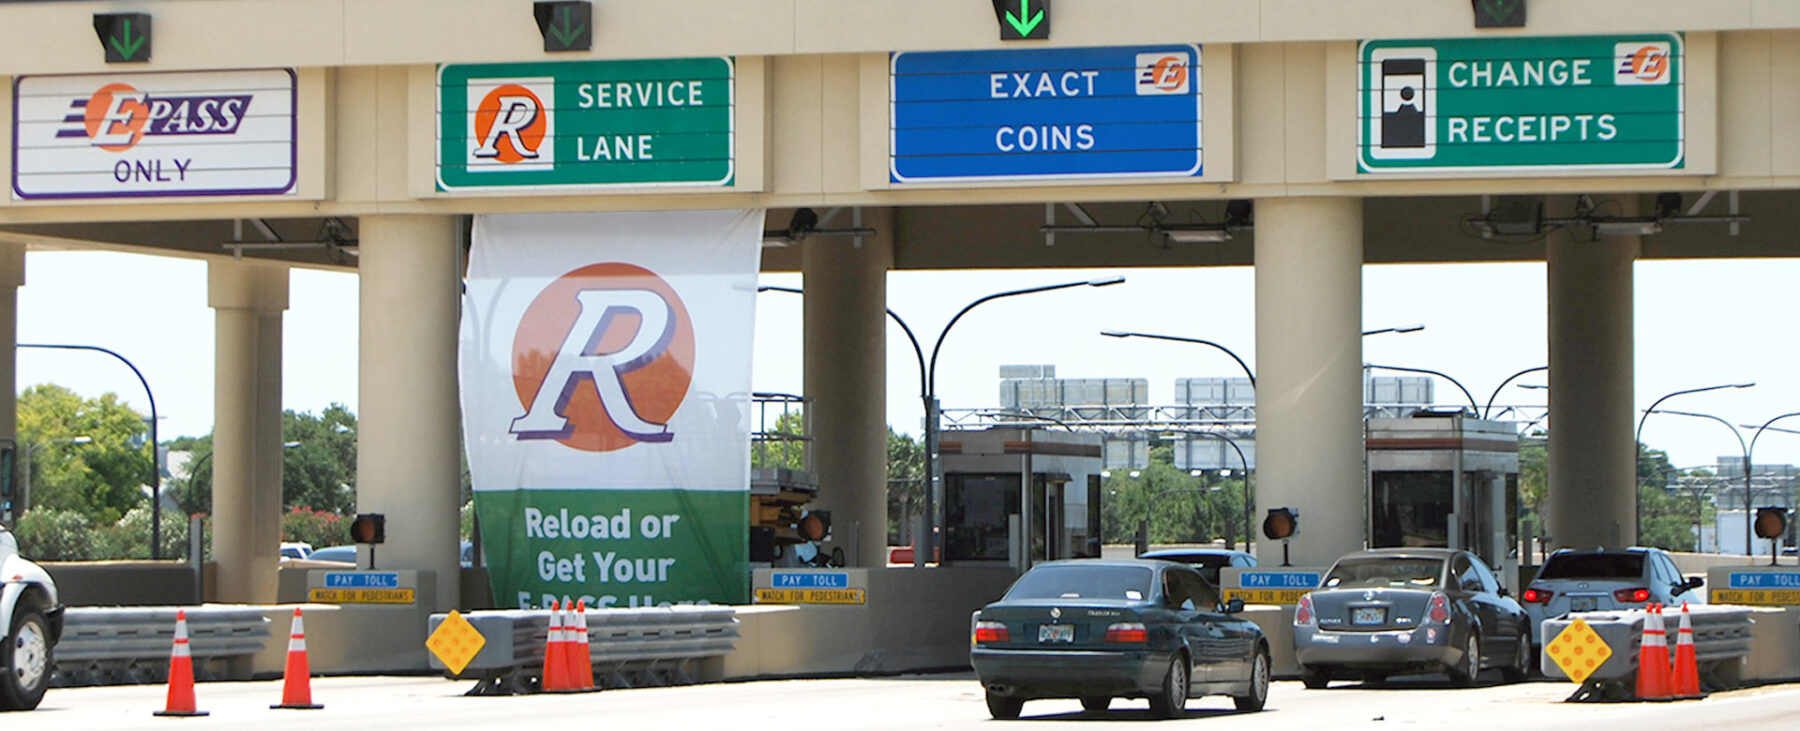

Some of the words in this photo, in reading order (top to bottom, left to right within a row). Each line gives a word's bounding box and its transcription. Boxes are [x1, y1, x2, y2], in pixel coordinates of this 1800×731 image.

[990, 71, 1099, 98] EXACT
[1448, 59, 1592, 88] CHANGE
[577, 81, 704, 108] SERVICE
[995, 124, 1095, 151] COINS
[1448, 114, 1618, 143] RECEIPTS
[577, 135, 653, 161] LANE
[114, 158, 192, 182] ONLY
[524, 507, 631, 539] Reload
[640, 514, 680, 538] or
[537, 550, 585, 582] Get
[592, 551, 676, 582] Your
[334, 575, 354, 585] PAY
[364, 575, 388, 585] TOLL
[782, 575, 802, 585] PAY
[813, 575, 837, 585] TOLL
[1250, 575, 1271, 585] PAY
[1283, 575, 1308, 585] TOLL
[1740, 575, 1761, 585] PAY
[316, 590, 338, 599] WATCH
[343, 590, 357, 599] FOR
[362, 590, 409, 600] PEDESTRIANS
[762, 591, 785, 600] WATCH
[791, 591, 805, 600] FOR
[1260, 591, 1274, 600] FOR
[1750, 591, 1764, 602] FOR
